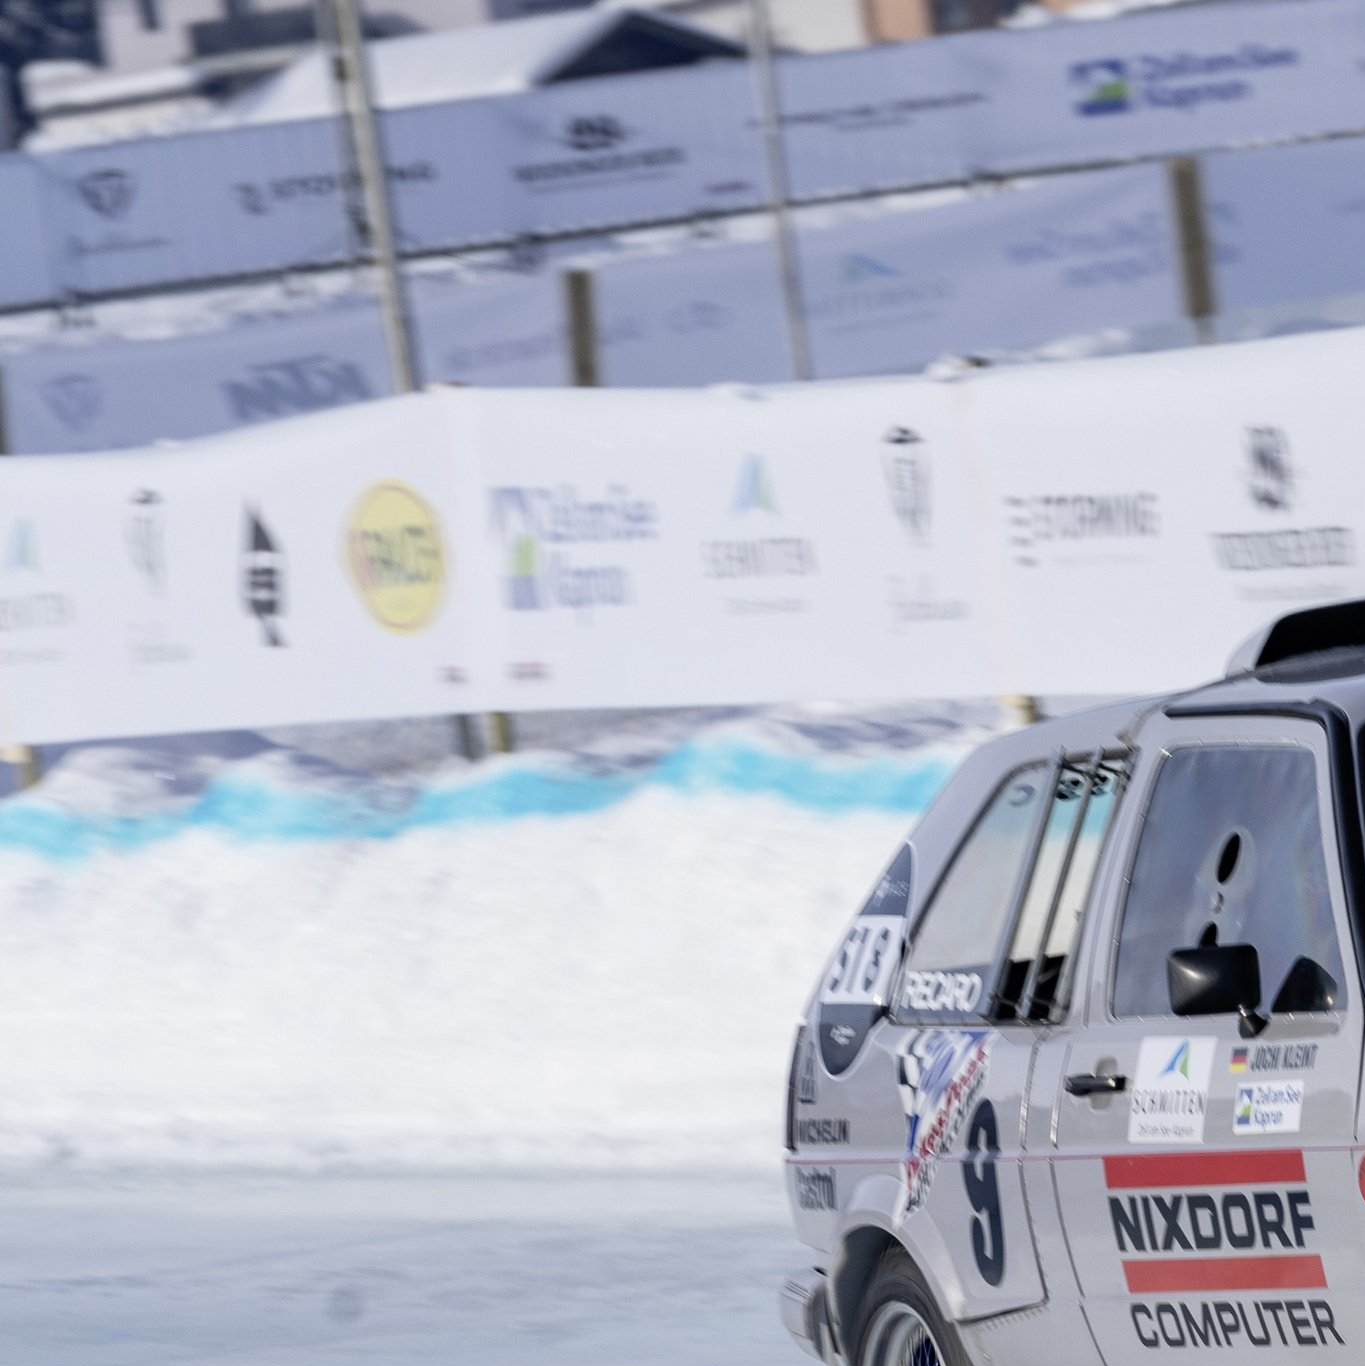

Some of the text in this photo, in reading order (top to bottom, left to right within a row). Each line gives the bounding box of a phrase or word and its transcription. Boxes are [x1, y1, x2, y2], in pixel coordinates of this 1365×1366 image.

[899, 970, 983, 1013] RECARO
[1131, 1089, 1207, 1115] SCHMITTEN
[962, 1097, 1006, 1288] 9
[1107, 1189, 1315, 1252] NIXDORF
[1130, 1298, 1346, 1349] COMPUTER
